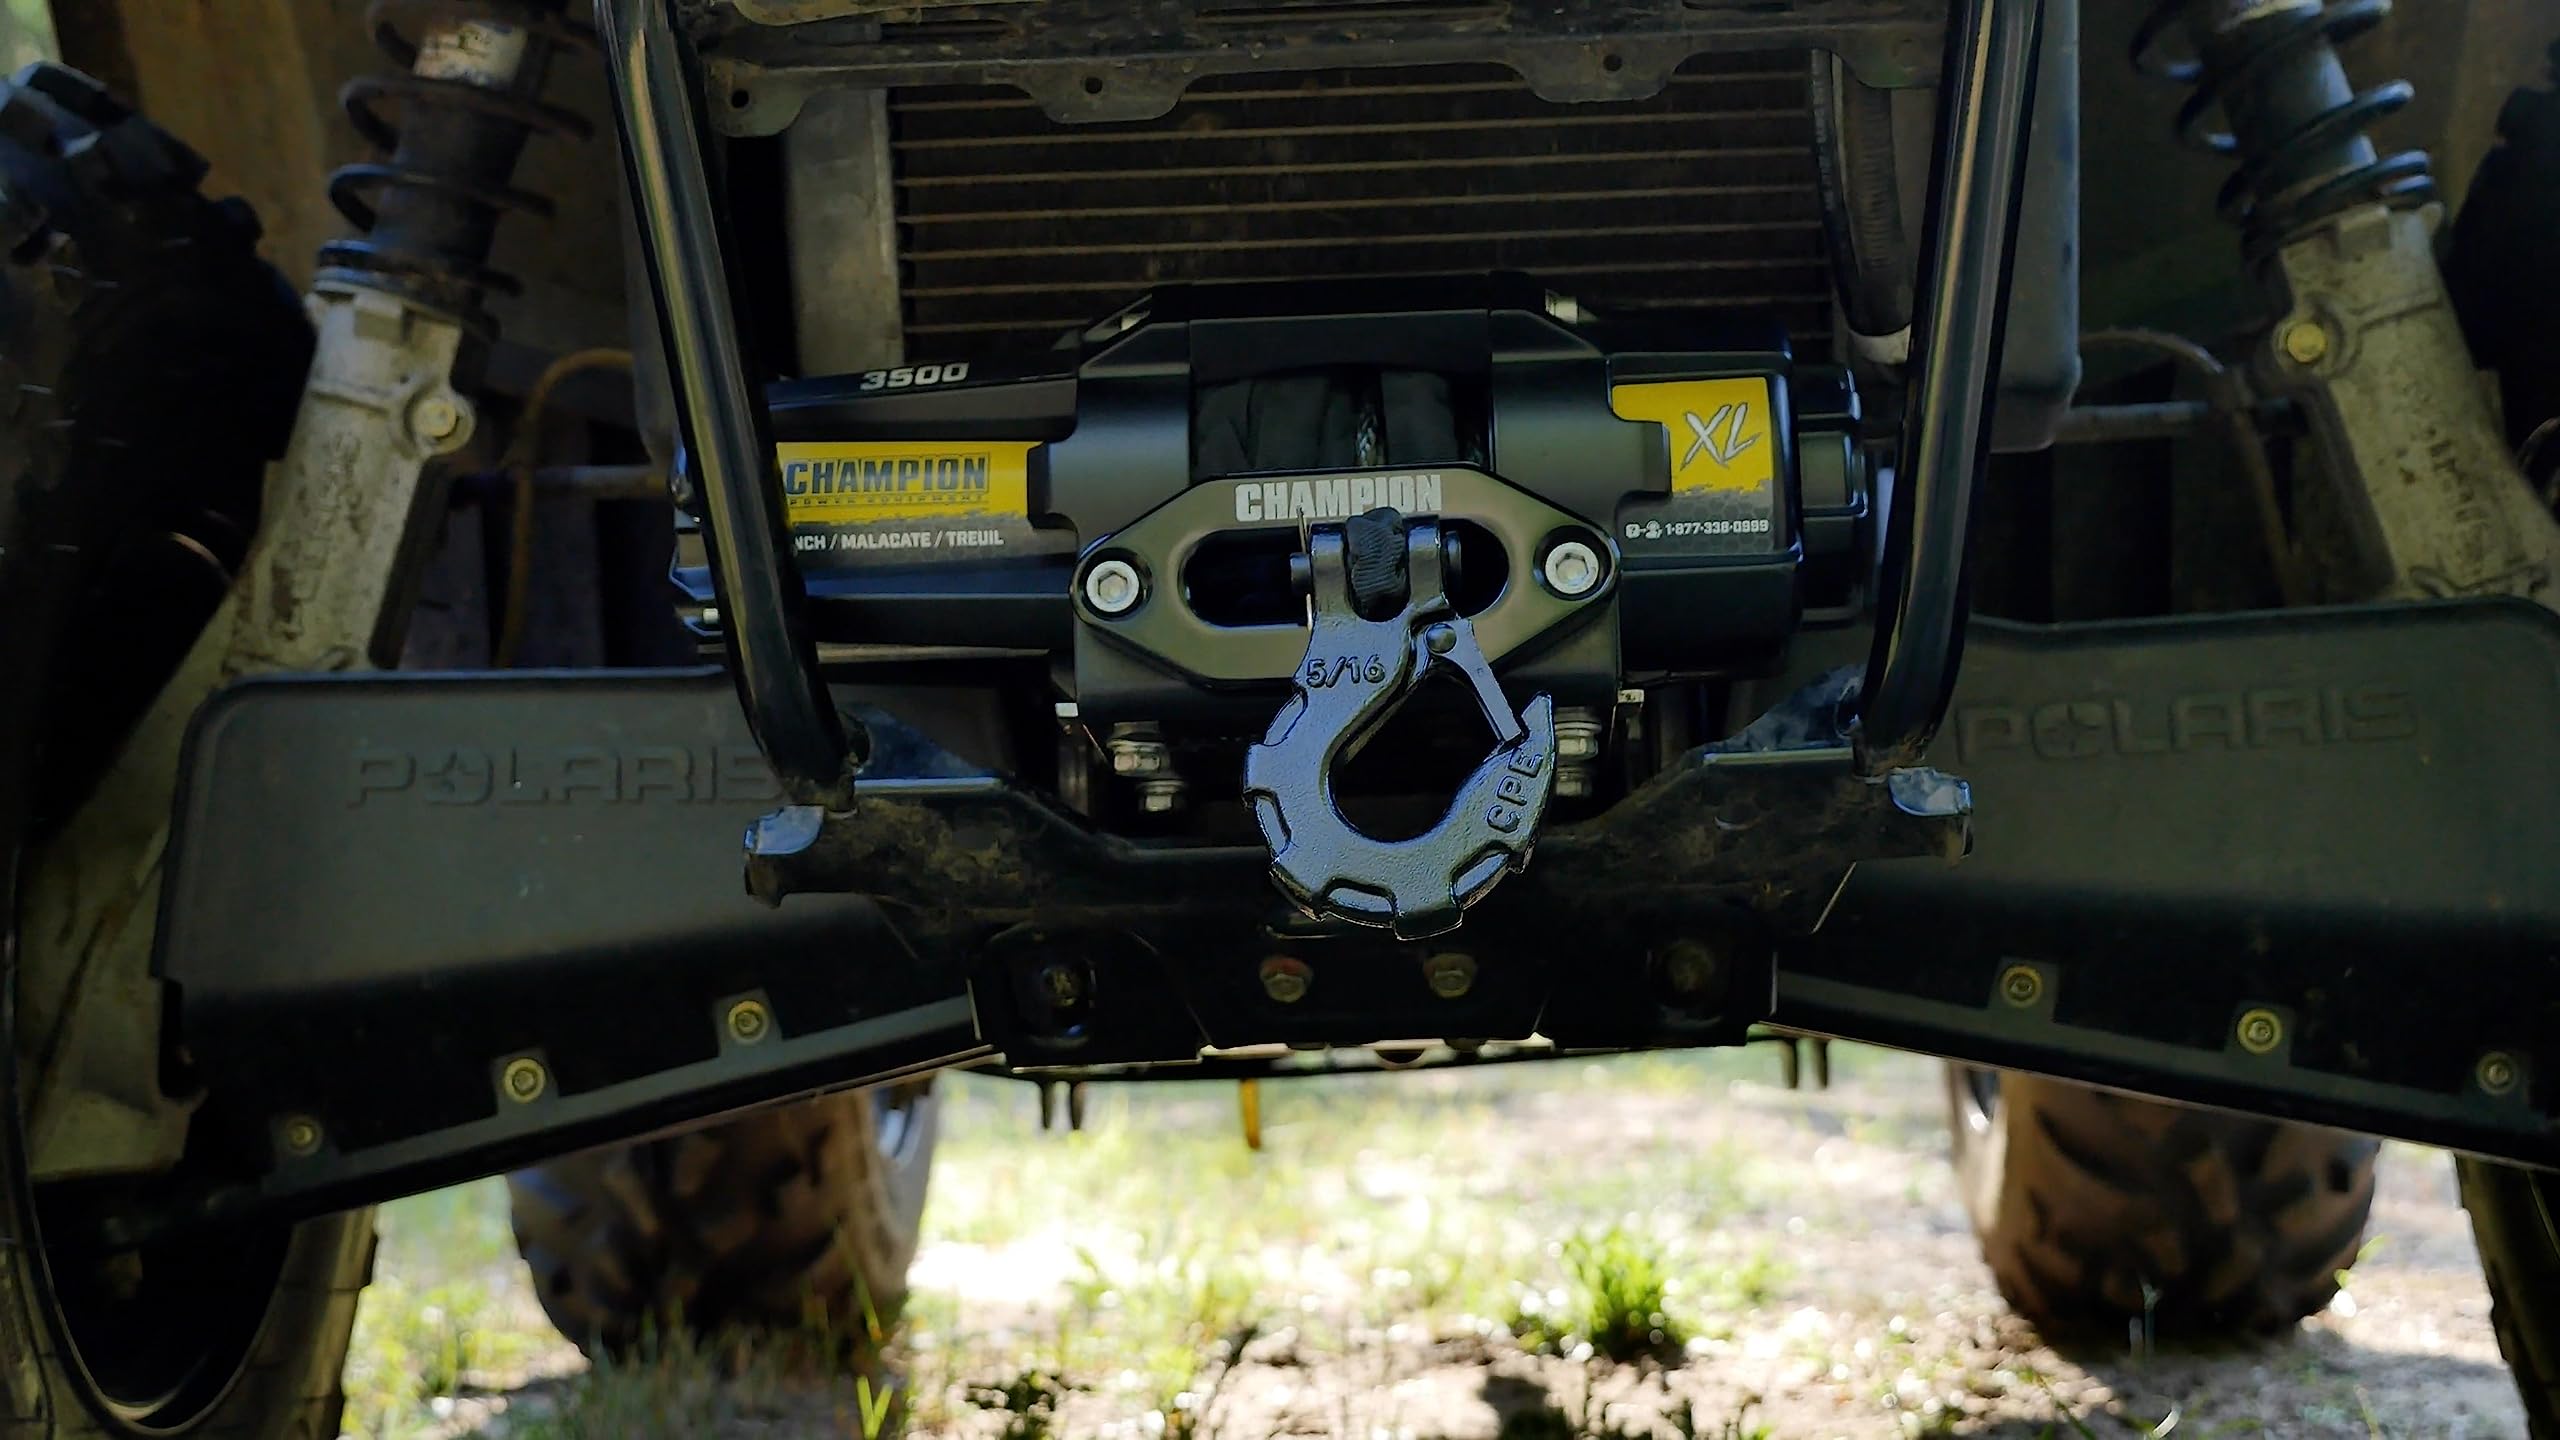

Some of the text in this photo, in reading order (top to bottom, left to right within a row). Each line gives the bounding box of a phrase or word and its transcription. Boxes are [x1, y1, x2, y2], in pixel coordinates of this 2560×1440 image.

[860, 361, 970, 391] 3500
[1680, 402, 1763, 472] XL
[785, 455, 986, 496] CHAMPION
[1235, 474, 1442, 522] CHAMPION
[841, 532, 932, 550] MALACATE
[945, 529, 1005, 547] TREUIL
[1306, 654, 1386, 688] 5/16
[1956, 682, 2418, 767] POLARIS
[1486, 747, 1543, 834] CPE
